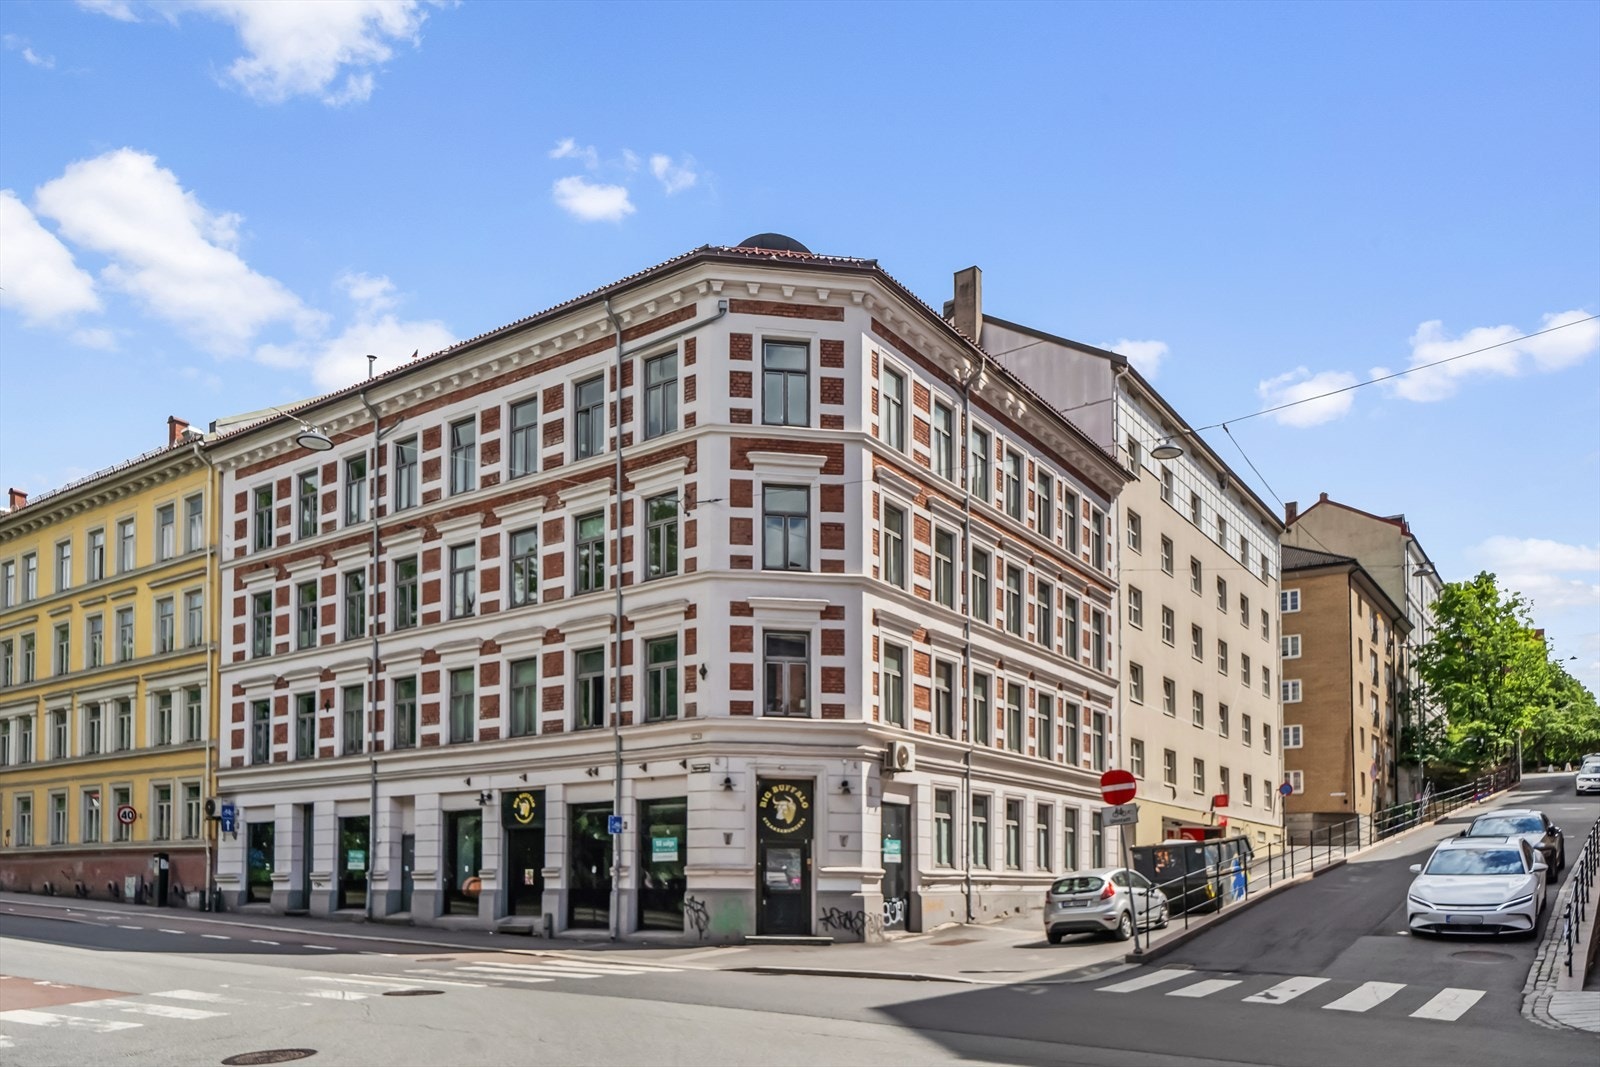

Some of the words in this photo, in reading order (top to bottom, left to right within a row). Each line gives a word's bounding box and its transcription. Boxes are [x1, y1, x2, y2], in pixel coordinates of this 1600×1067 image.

[759, 790, 772, 808] BIG
[771, 784, 809, 809] BUFFALO
[121, 810, 134, 820] 40
